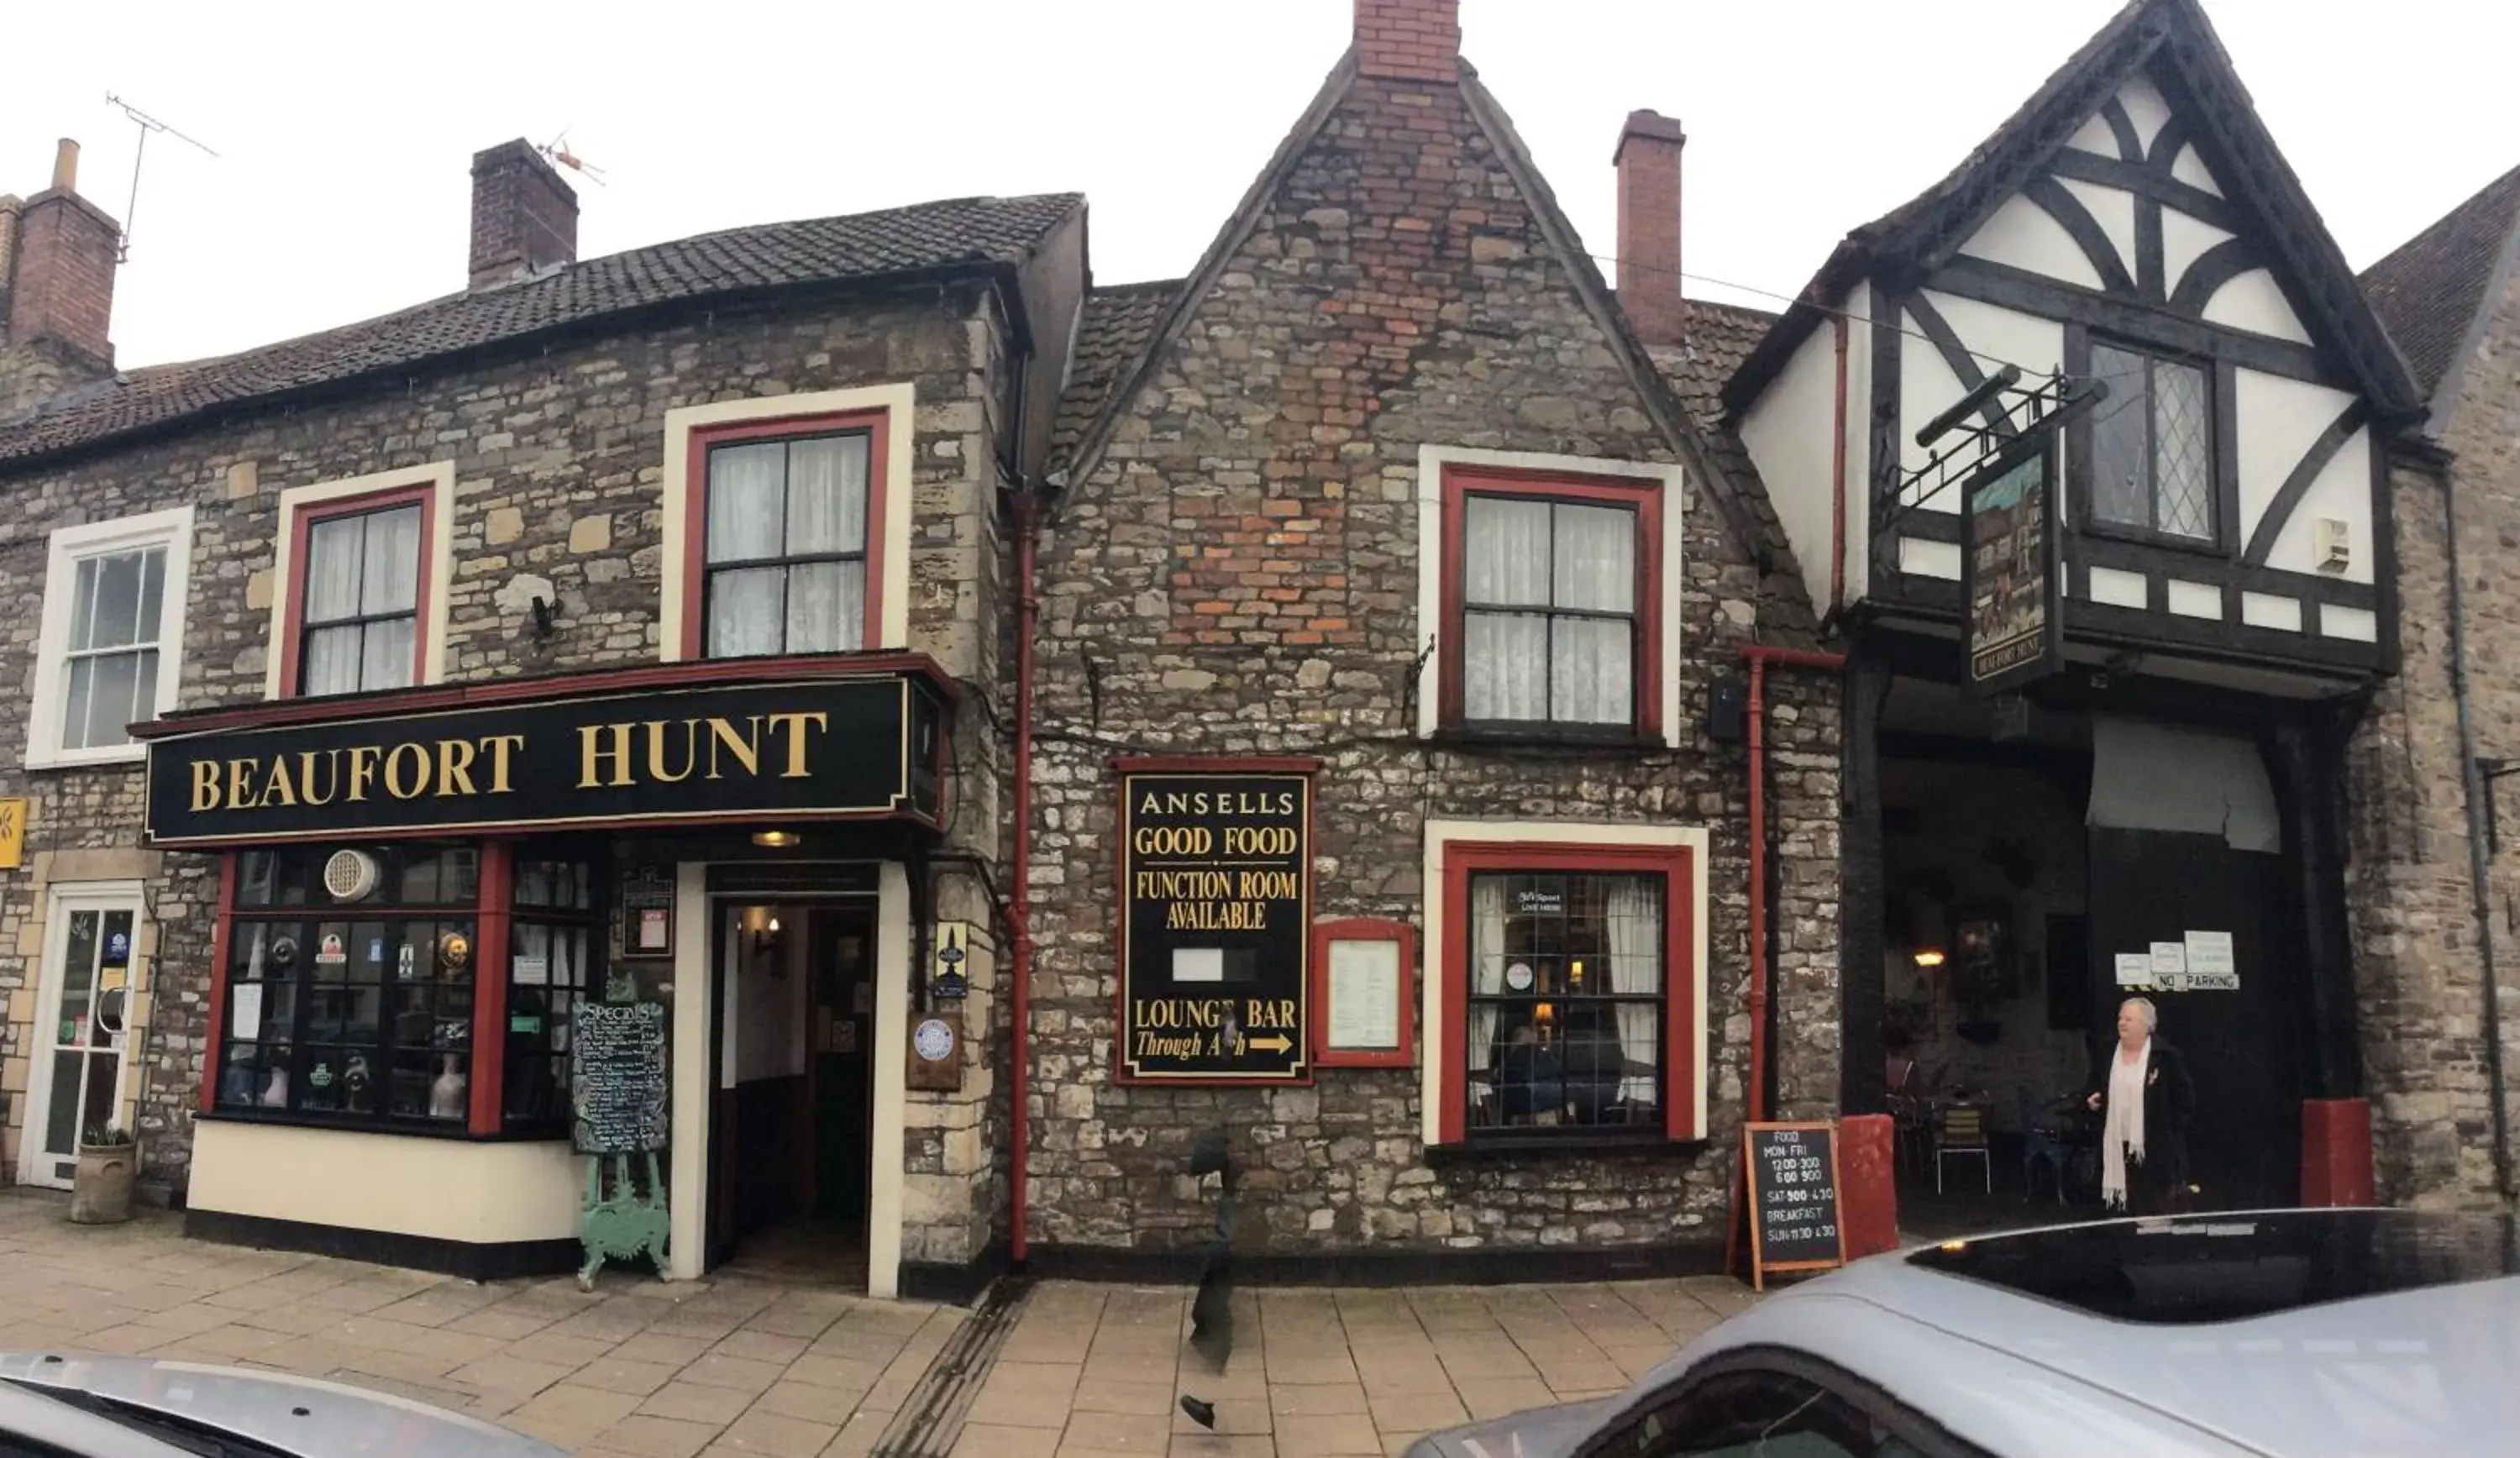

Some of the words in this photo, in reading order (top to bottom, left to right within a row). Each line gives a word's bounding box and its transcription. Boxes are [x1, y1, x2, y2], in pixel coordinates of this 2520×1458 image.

[189, 735, 524, 812] BEAUFORT
[575, 712, 827, 789] HUNT
[1140, 792, 1294, 816] ANSELLS
[1135, 827, 1213, 855] GOOD
[1223, 827, 1298, 855] FOOD
[1137, 871, 1232, 899] FUNCTION
[1239, 871, 1298, 900] ROOM
[1166, 901, 1267, 930] AVAILABLE
[2160, 975, 2175, 987] NO
[2187, 975, 2235, 989] PARKING
[1247, 999, 1296, 1028] BAR
[1137, 1031, 1202, 1061] Through
[1206, 1031, 1246, 1057] Ah
[1774, 1130, 1799, 1143] FOOD
[1767, 1207, 1824, 1223] BREAKFAST
